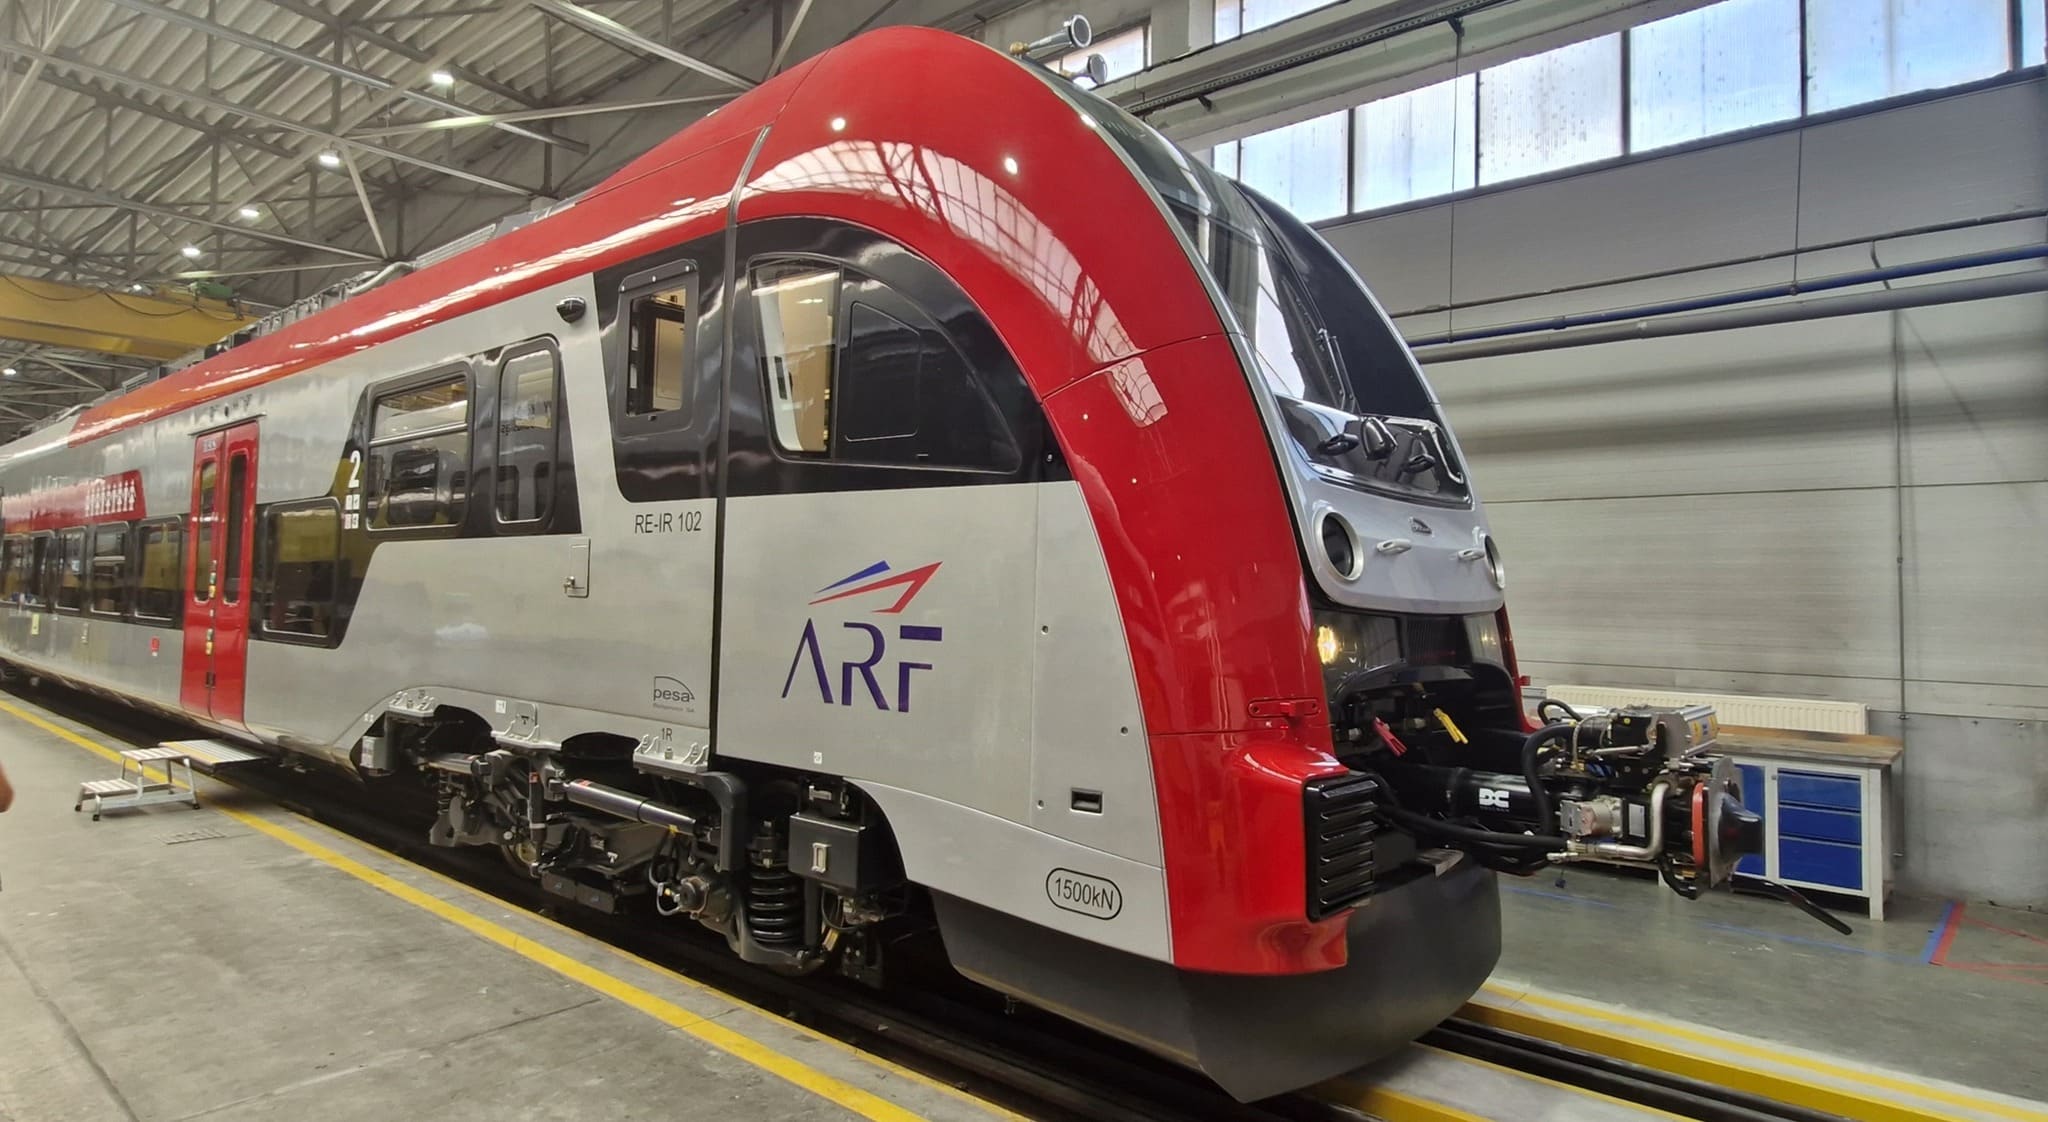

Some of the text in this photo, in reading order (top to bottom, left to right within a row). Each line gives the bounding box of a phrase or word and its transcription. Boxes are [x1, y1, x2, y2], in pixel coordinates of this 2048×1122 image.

[348, 450, 361, 489] 2
[634, 511, 702, 534] RE-IR 102
[781, 617, 943, 713] ARF
[653, 688, 690, 702] pesa
[1055, 877, 1114, 911] 1500kN
